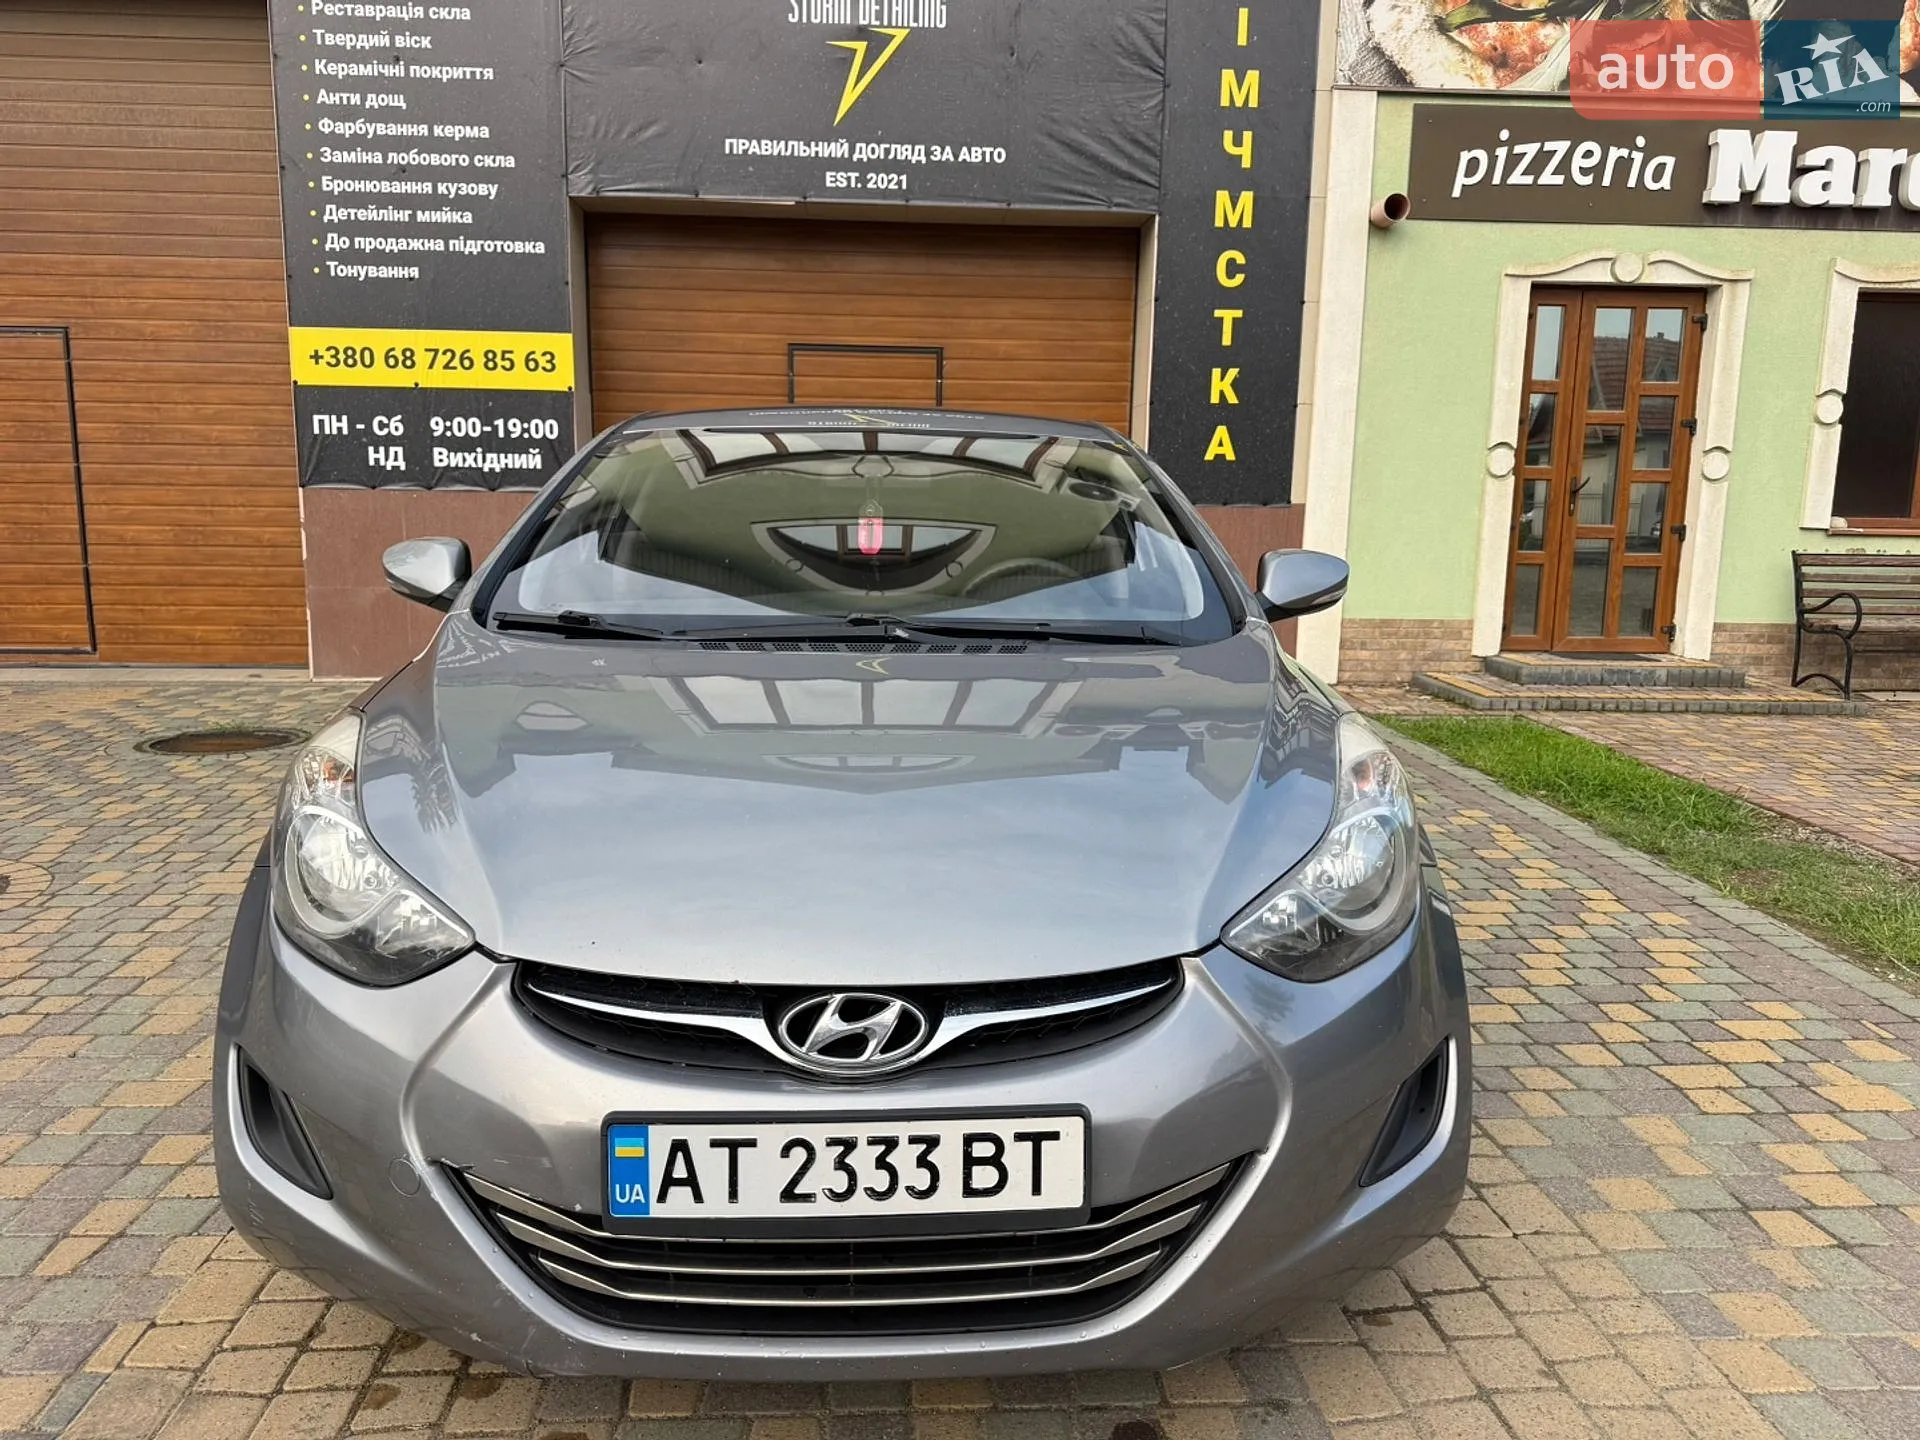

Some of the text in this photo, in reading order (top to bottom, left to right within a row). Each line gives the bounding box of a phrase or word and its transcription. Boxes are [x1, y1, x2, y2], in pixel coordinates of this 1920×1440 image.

[311, 2, 471, 21] Реставрація скла
[313, 29, 432, 50] Твердий віск
[314, 59, 494, 82] Керамічні покриття
[316, 89, 406, 109] Анти дощ
[318, 118, 489, 140] Фарбування керма
[320, 148, 515, 167] Заміна лобового скла
[725, 138, 1007, 163] ПРАВИЛЬНИЙ ДОГЛЯД ЗА АВТО
[1451, 129, 1676, 198] pizzeria
[321, 176, 499, 199] Бронювання кузову
[825, 172, 907, 189] EST. 2021
[323, 205, 472, 224] Детейлінг мийка
[325, 234, 545, 254] До продажна підготовка
[326, 262, 419, 281] Тонування
[309, 346, 556, 373] +380 68 726 85 63
[313, 415, 348, 435] ПН
[372, 415, 404, 436] Сб
[429, 417, 559, 439] 9:00-19:00
[368, 446, 542, 473] НД Вихідний
[656, 1131, 1061, 1203] AT 2333 BT
[615, 1184, 645, 1203] UA
